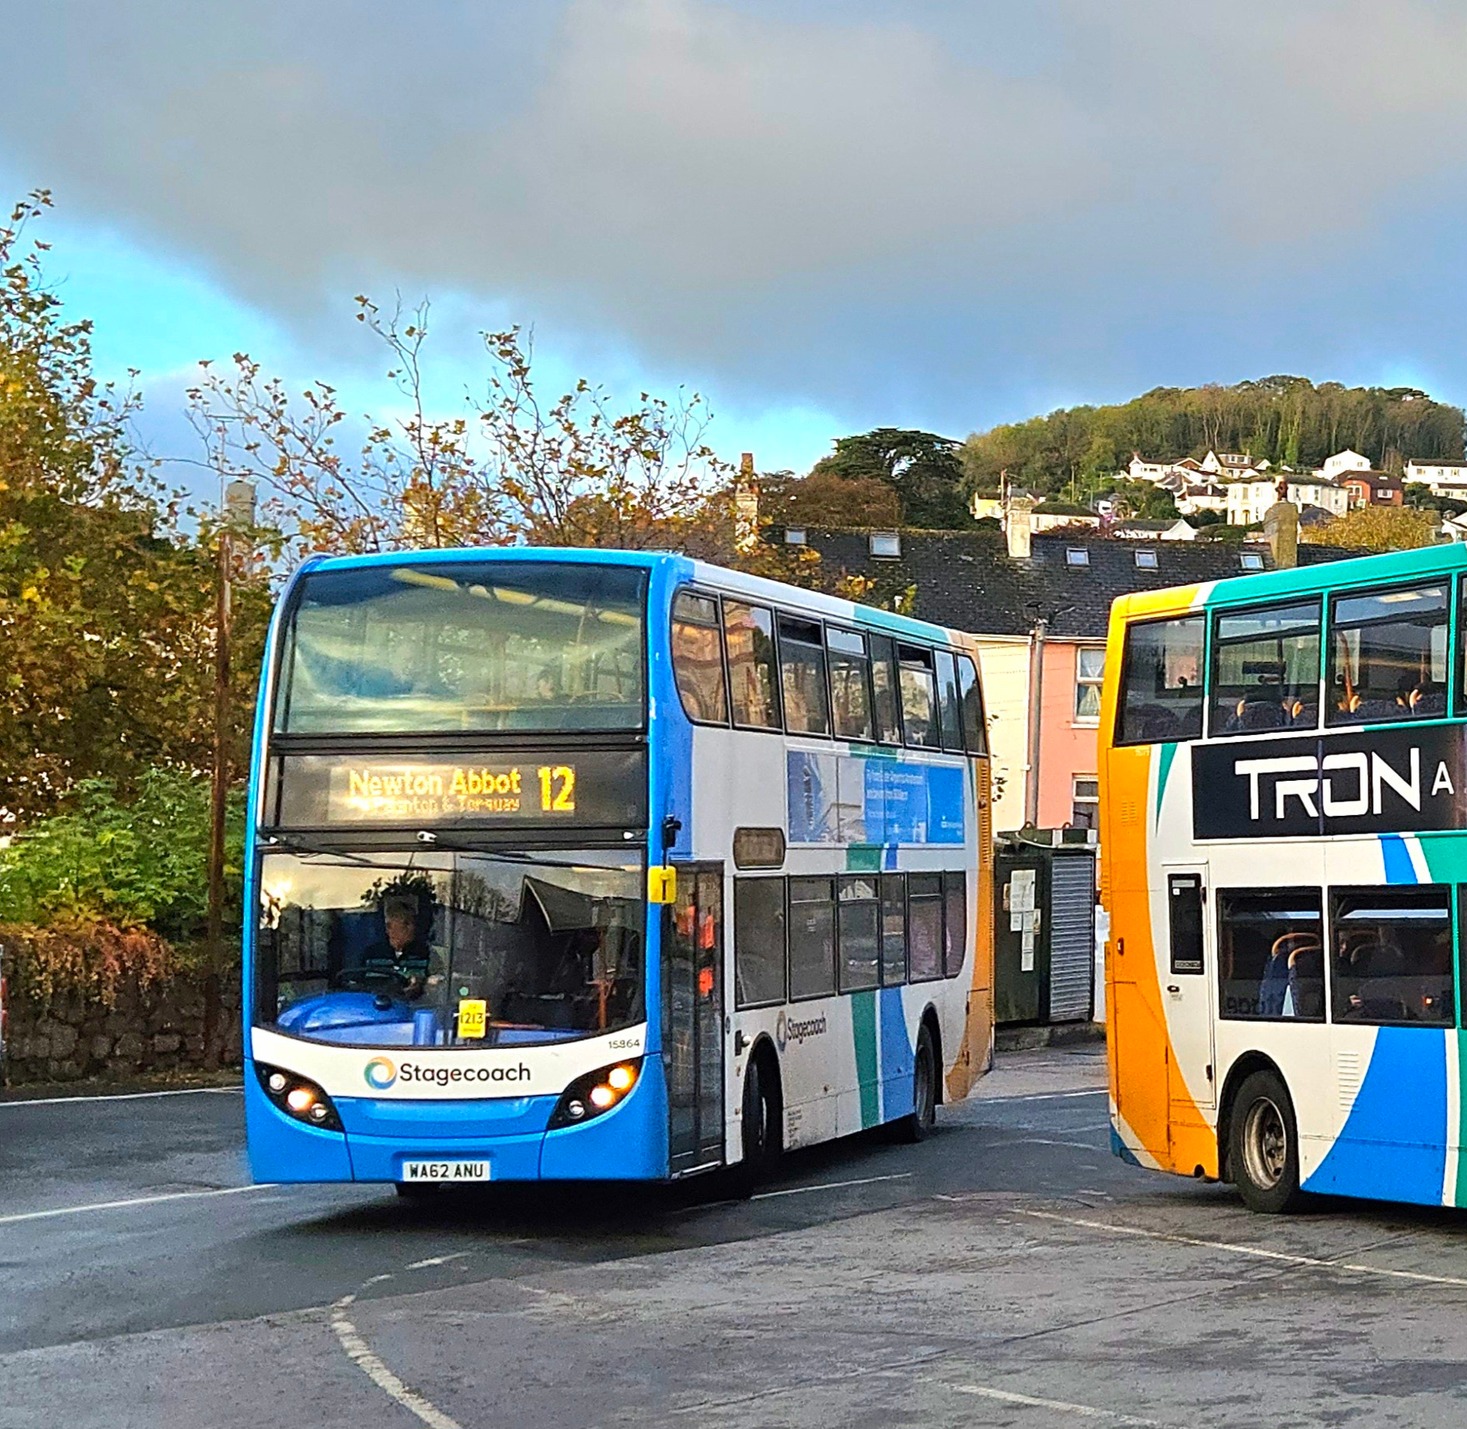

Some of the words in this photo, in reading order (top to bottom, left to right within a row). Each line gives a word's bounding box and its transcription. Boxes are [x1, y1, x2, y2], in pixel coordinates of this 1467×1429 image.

[350, 767, 443, 796] Newton
[450, 767, 522, 795] Abbot
[537, 765, 576, 811] 12
[1235, 747, 1421, 820] TRON
[460, 1012, 484, 1024] 1213
[787, 1010, 827, 1045] Stagecoach
[400, 1062, 531, 1086] Stagecoach
[409, 1163, 449, 1179] WA62
[453, 1162, 484, 1178] ANU
